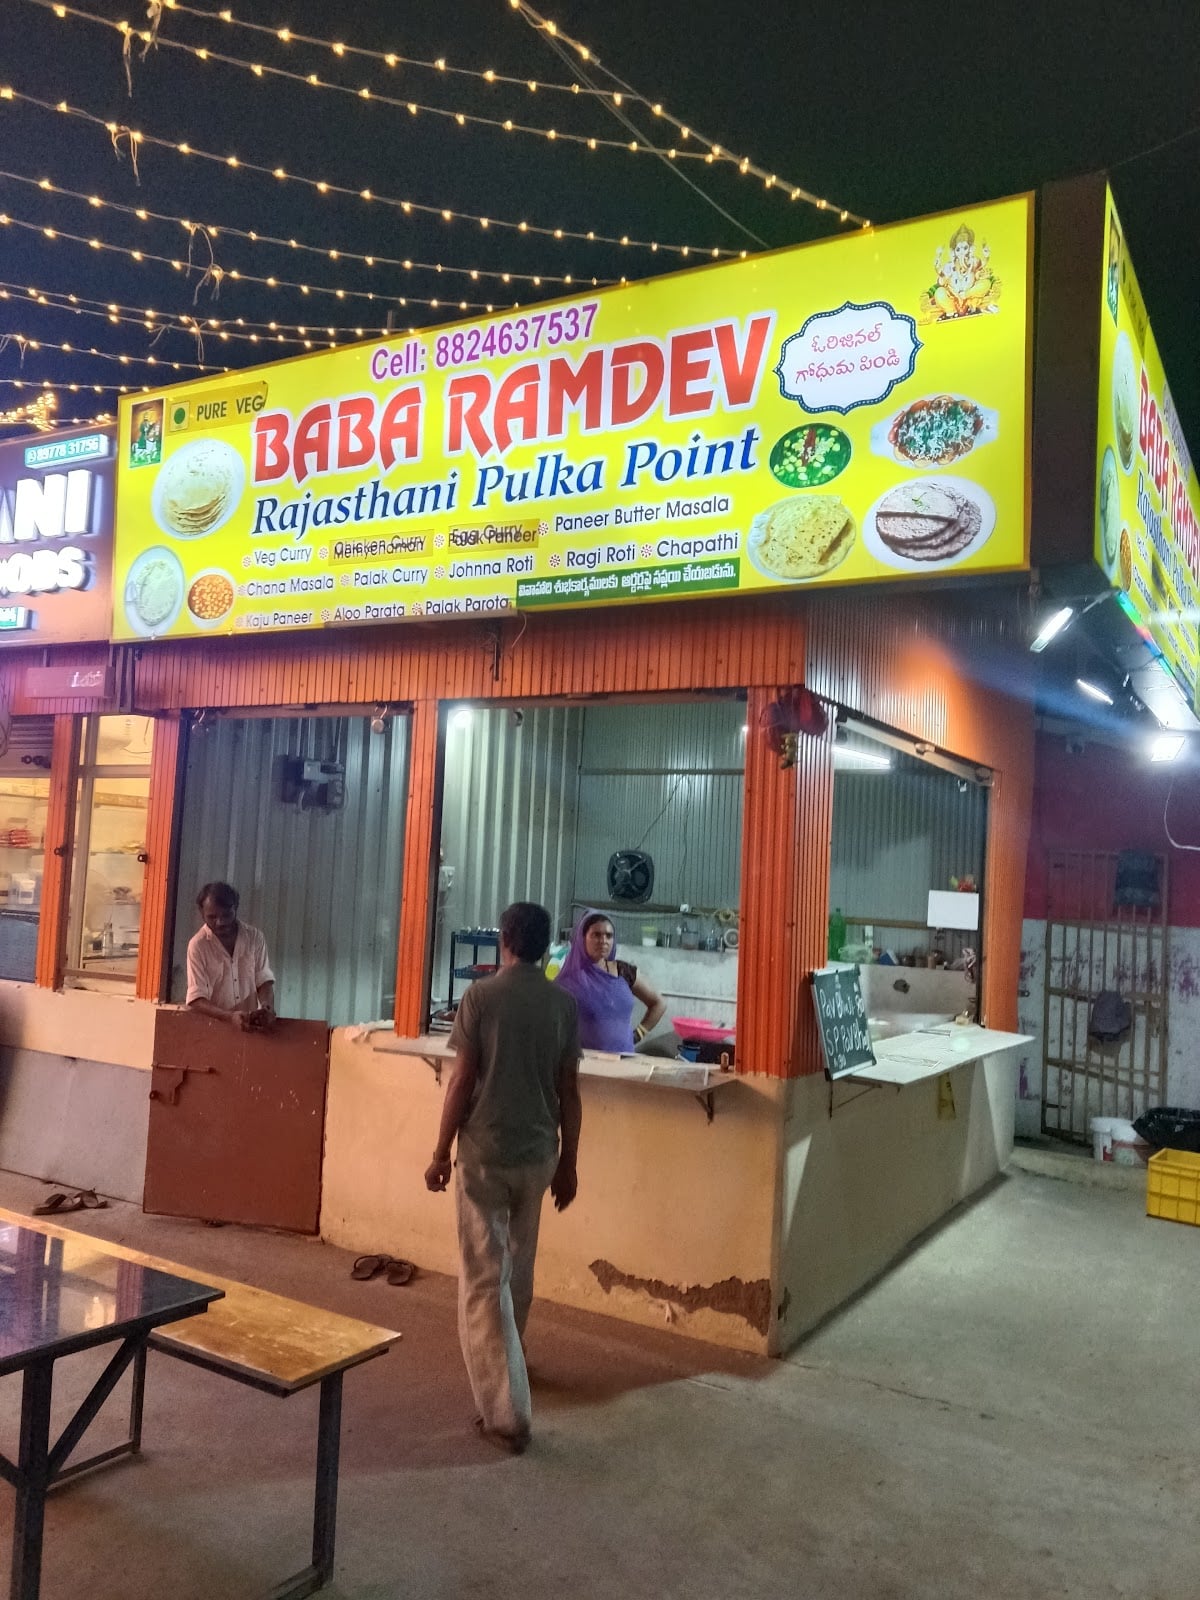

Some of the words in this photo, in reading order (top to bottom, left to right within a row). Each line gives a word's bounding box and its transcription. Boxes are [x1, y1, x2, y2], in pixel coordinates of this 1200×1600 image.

[372, 342, 426, 380] Cell:
[436, 303, 598, 368] 8824637537
[812, 323, 883, 353] ఓరిజినల్
[796, 360, 855, 383] గోధుమ
[860, 348, 900, 372] పిండి
[197, 401, 227, 421] PURE
[236, 395, 265, 414] VEG
[253, 387, 421, 484] BABA
[448, 317, 771, 458] RAMDEV
[252, 471, 458, 543] Rajasthani
[472, 454, 604, 507] Pulka
[621, 429, 760, 487] Point
[1139, 365, 1170, 512] BABA
[1171, 460, 1200, 588] RAMDE
[555, 512, 609, 532] Paneer
[614, 505, 661, 525] Butter
[666, 496, 729, 518] Masala
[255, 551, 276, 566] Veg
[280, 547, 312, 562] Curry
[566, 548, 601, 569] Ragi
[606, 544, 635, 563] Roti
[657, 533, 739, 558] Chapathi
[354, 570, 388, 586] Palak
[392, 568, 428, 584] Curry
[449, 559, 501, 579] Johnna
[507, 555, 533, 573] Roti
[247, 582, 286, 596] Chana
[291, 576, 334, 591] Masala
[334, 607, 361, 621] Aloo
[365, 602, 405, 618] Parata
[426, 599, 461, 614] Palak
[465, 595, 509, 612] Parota
[246, 614, 269, 629] Kaju
[273, 612, 312, 625] Paneer
